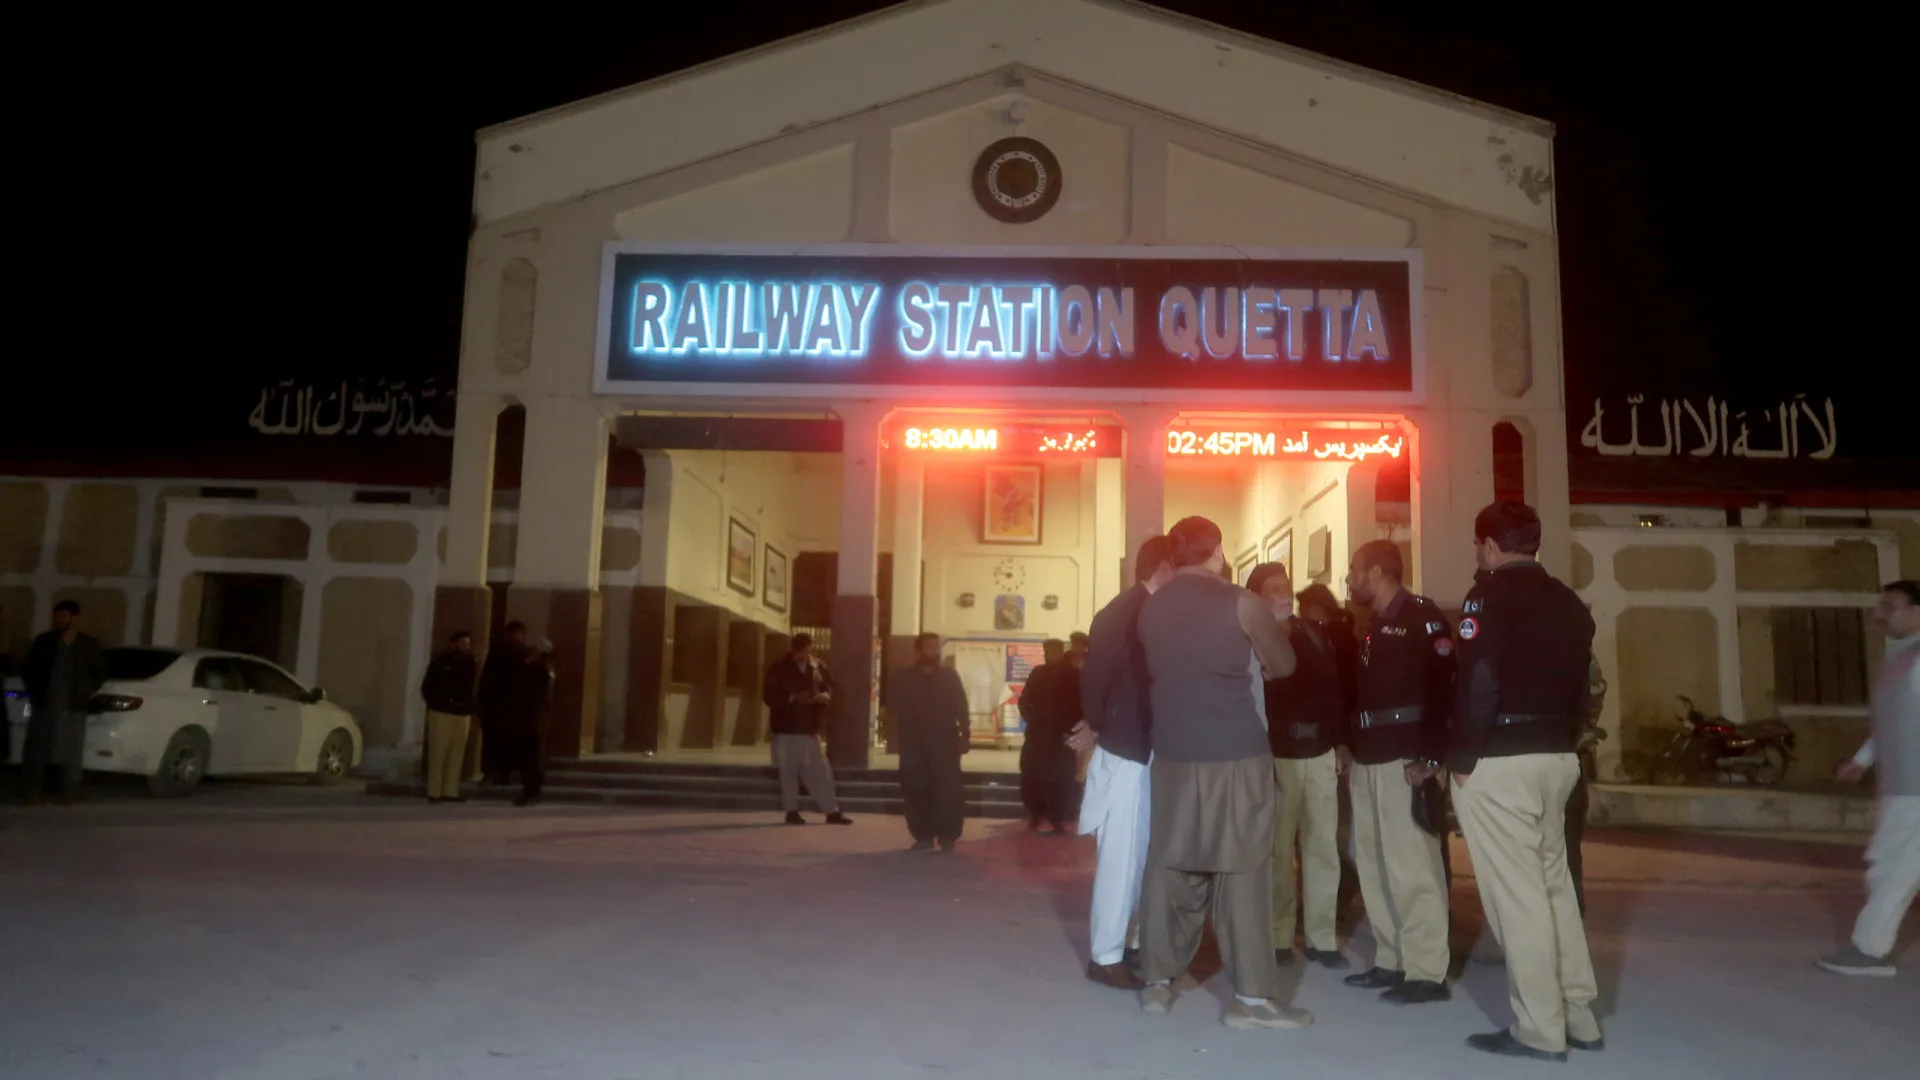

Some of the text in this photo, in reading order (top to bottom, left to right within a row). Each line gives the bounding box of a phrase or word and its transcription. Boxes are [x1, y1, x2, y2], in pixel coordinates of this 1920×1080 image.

[632, 280, 1390, 361] RAILWAY STATION QUETTA
[905, 428, 997, 450] 8:30AM
[1167, 431, 1276, 455] 02:45PM
